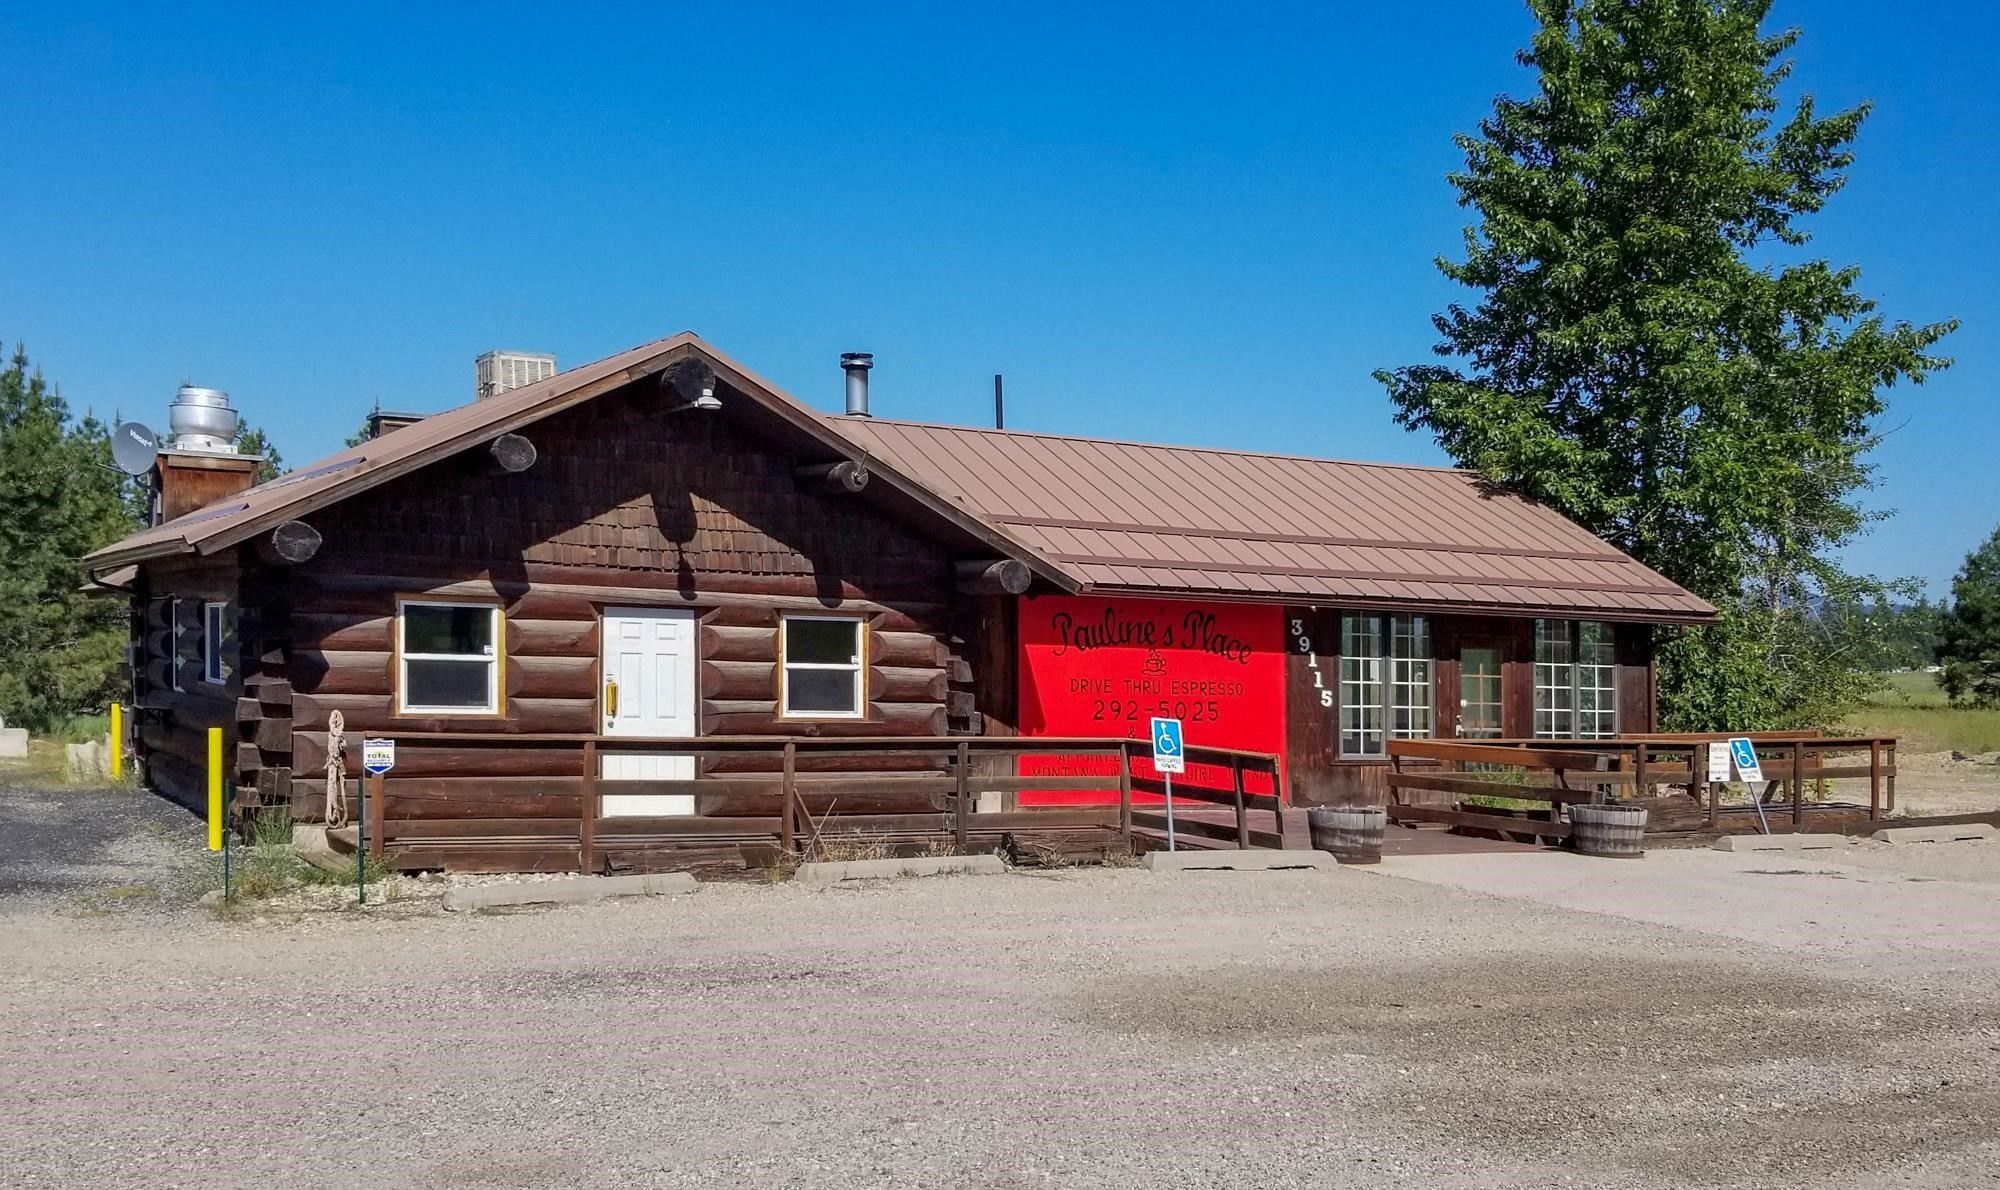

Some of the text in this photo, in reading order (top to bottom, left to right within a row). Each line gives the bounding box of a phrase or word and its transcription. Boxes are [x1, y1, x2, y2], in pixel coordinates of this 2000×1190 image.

[1052, 607, 1251, 665] Pauline's Place
[1070, 678, 1243, 696] DRIVE THRU ESPRESSO
[1093, 699, 1219, 721] 292-5025
[1128, 726, 1136, 738] &
[1111, 765, 1147, 779] WST
[1156, 766, 1215, 780] CGIRL
